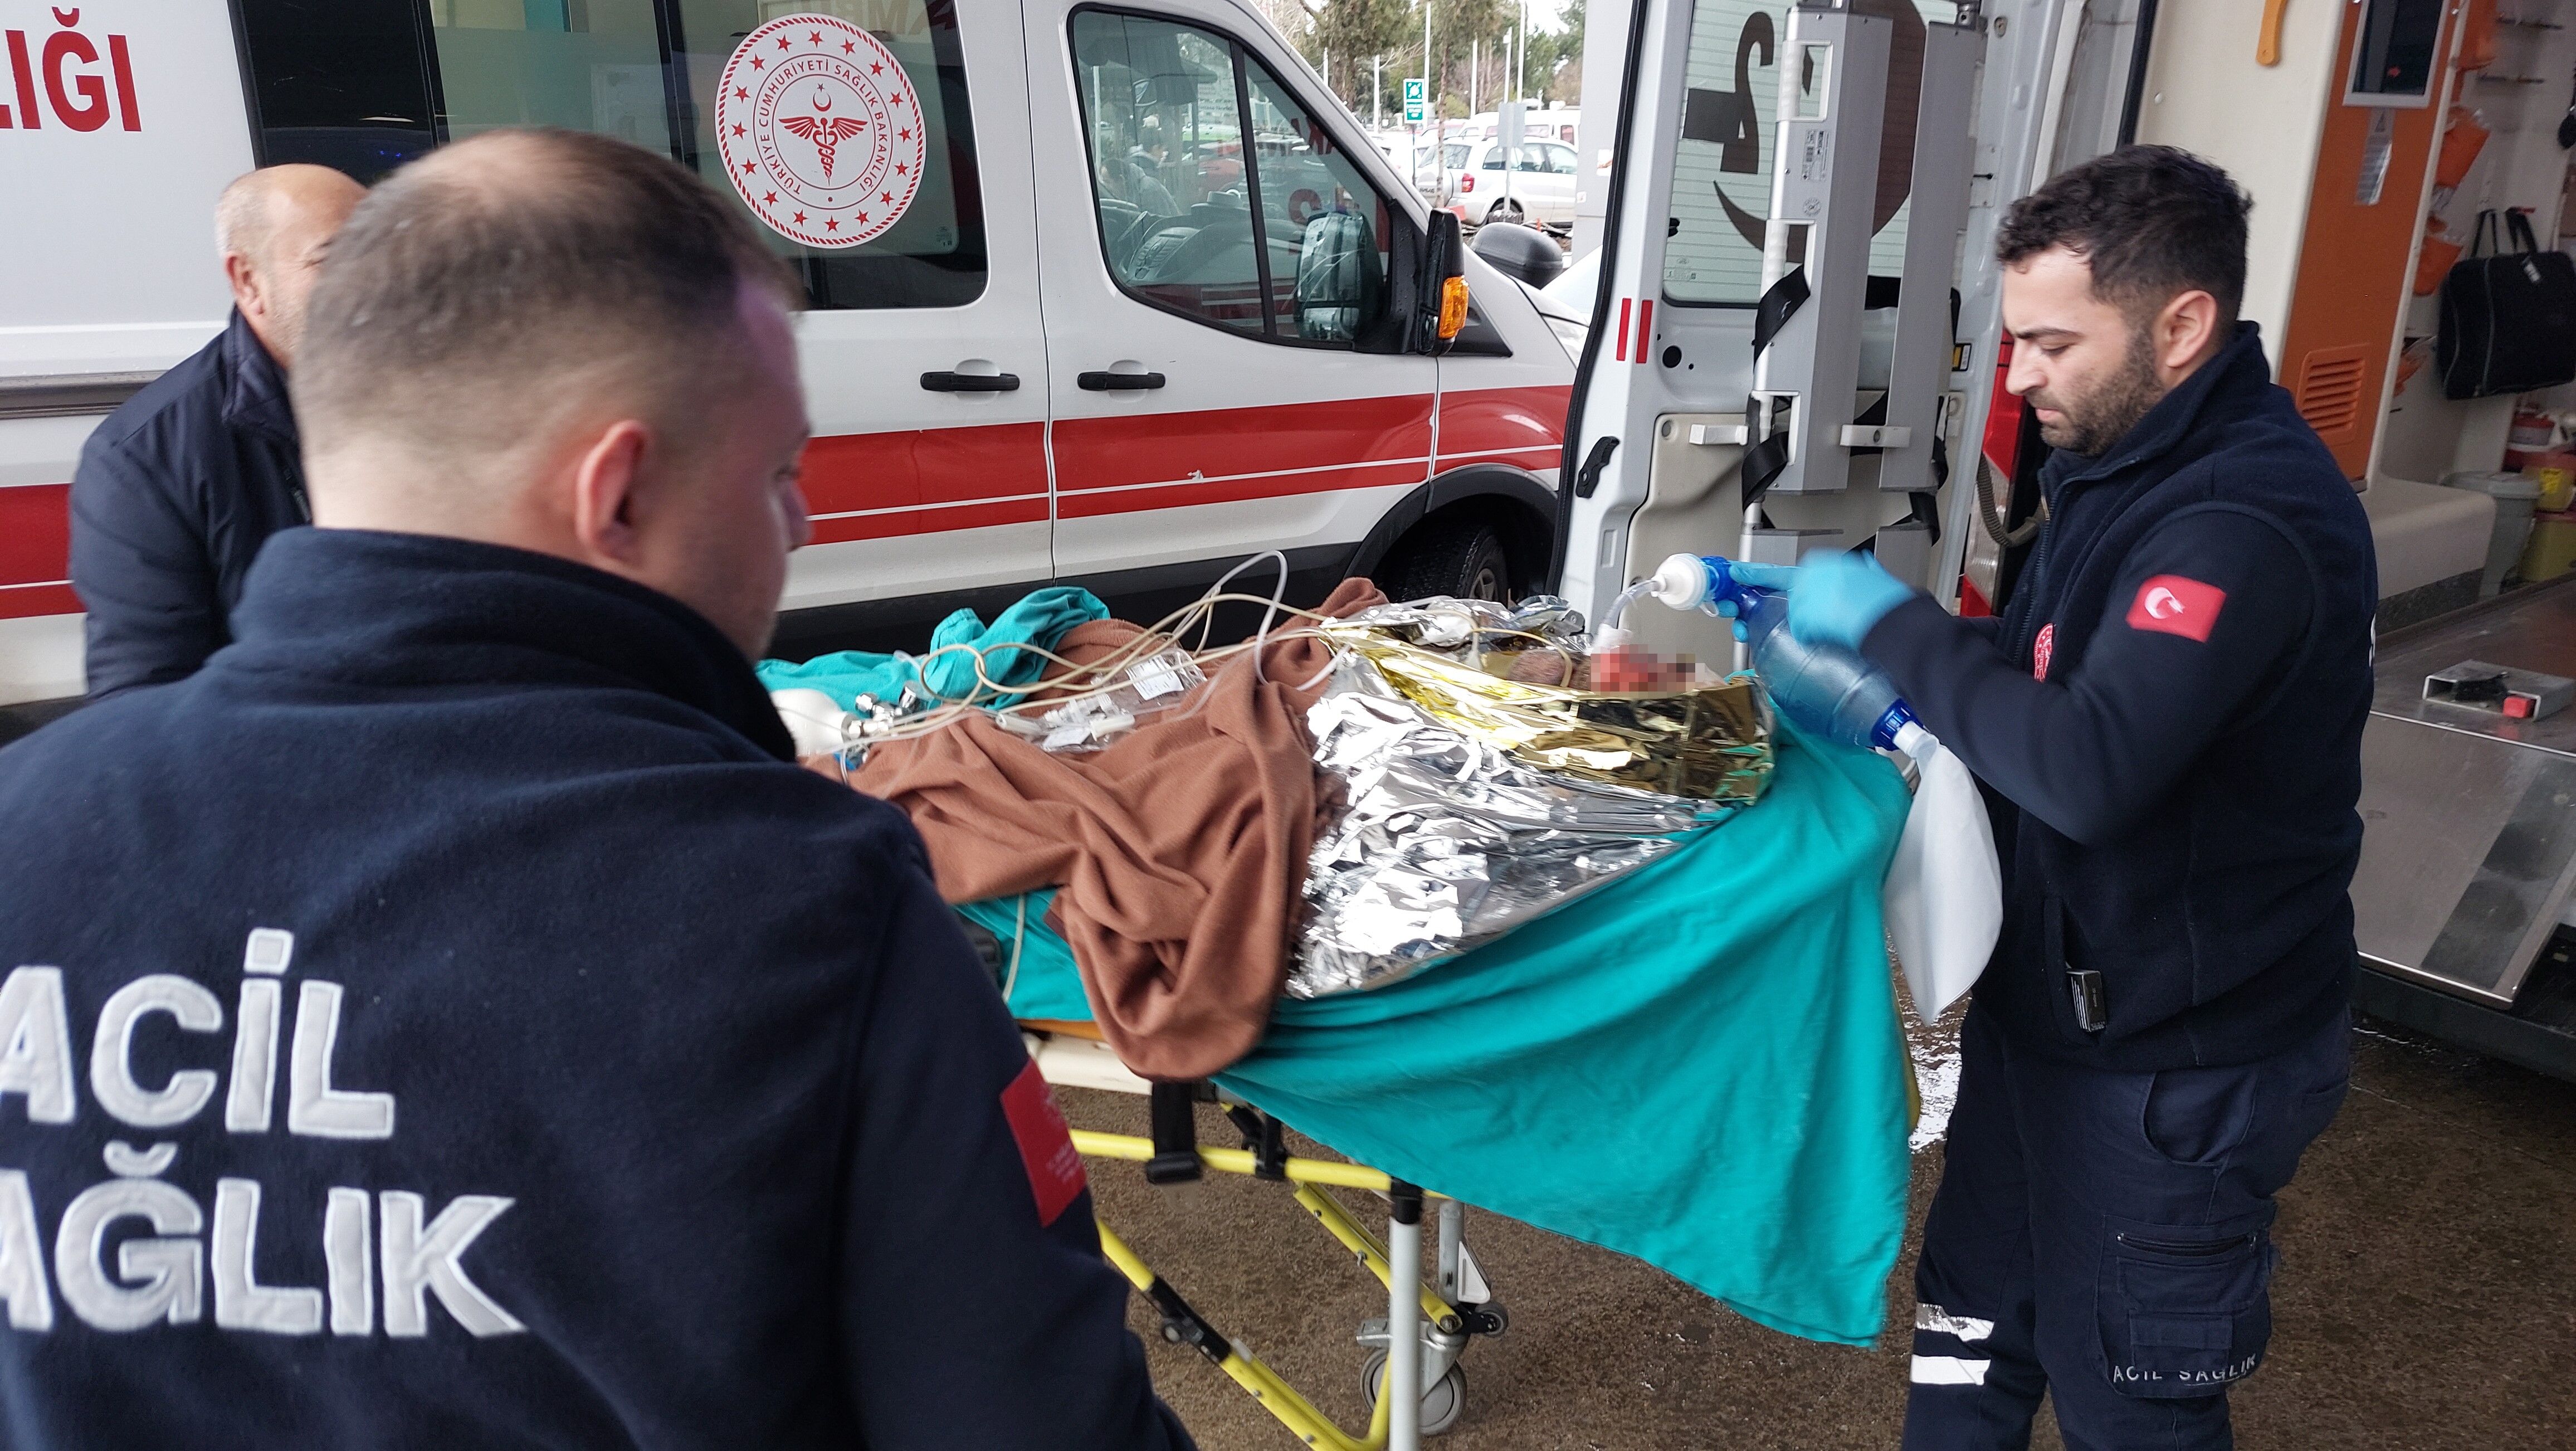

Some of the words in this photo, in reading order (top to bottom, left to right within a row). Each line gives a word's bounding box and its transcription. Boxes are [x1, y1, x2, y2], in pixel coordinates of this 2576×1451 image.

[0, 6, 142, 132] IĞI
[759, 59, 828, 127] CUMHURİYETİ
[835, 65, 878, 107] SAĞLIK
[760, 134, 801, 194] TÜRKİYE
[860, 111, 887, 191] BAKANLIĞI
[0, 928, 395, 1138] ACİL
